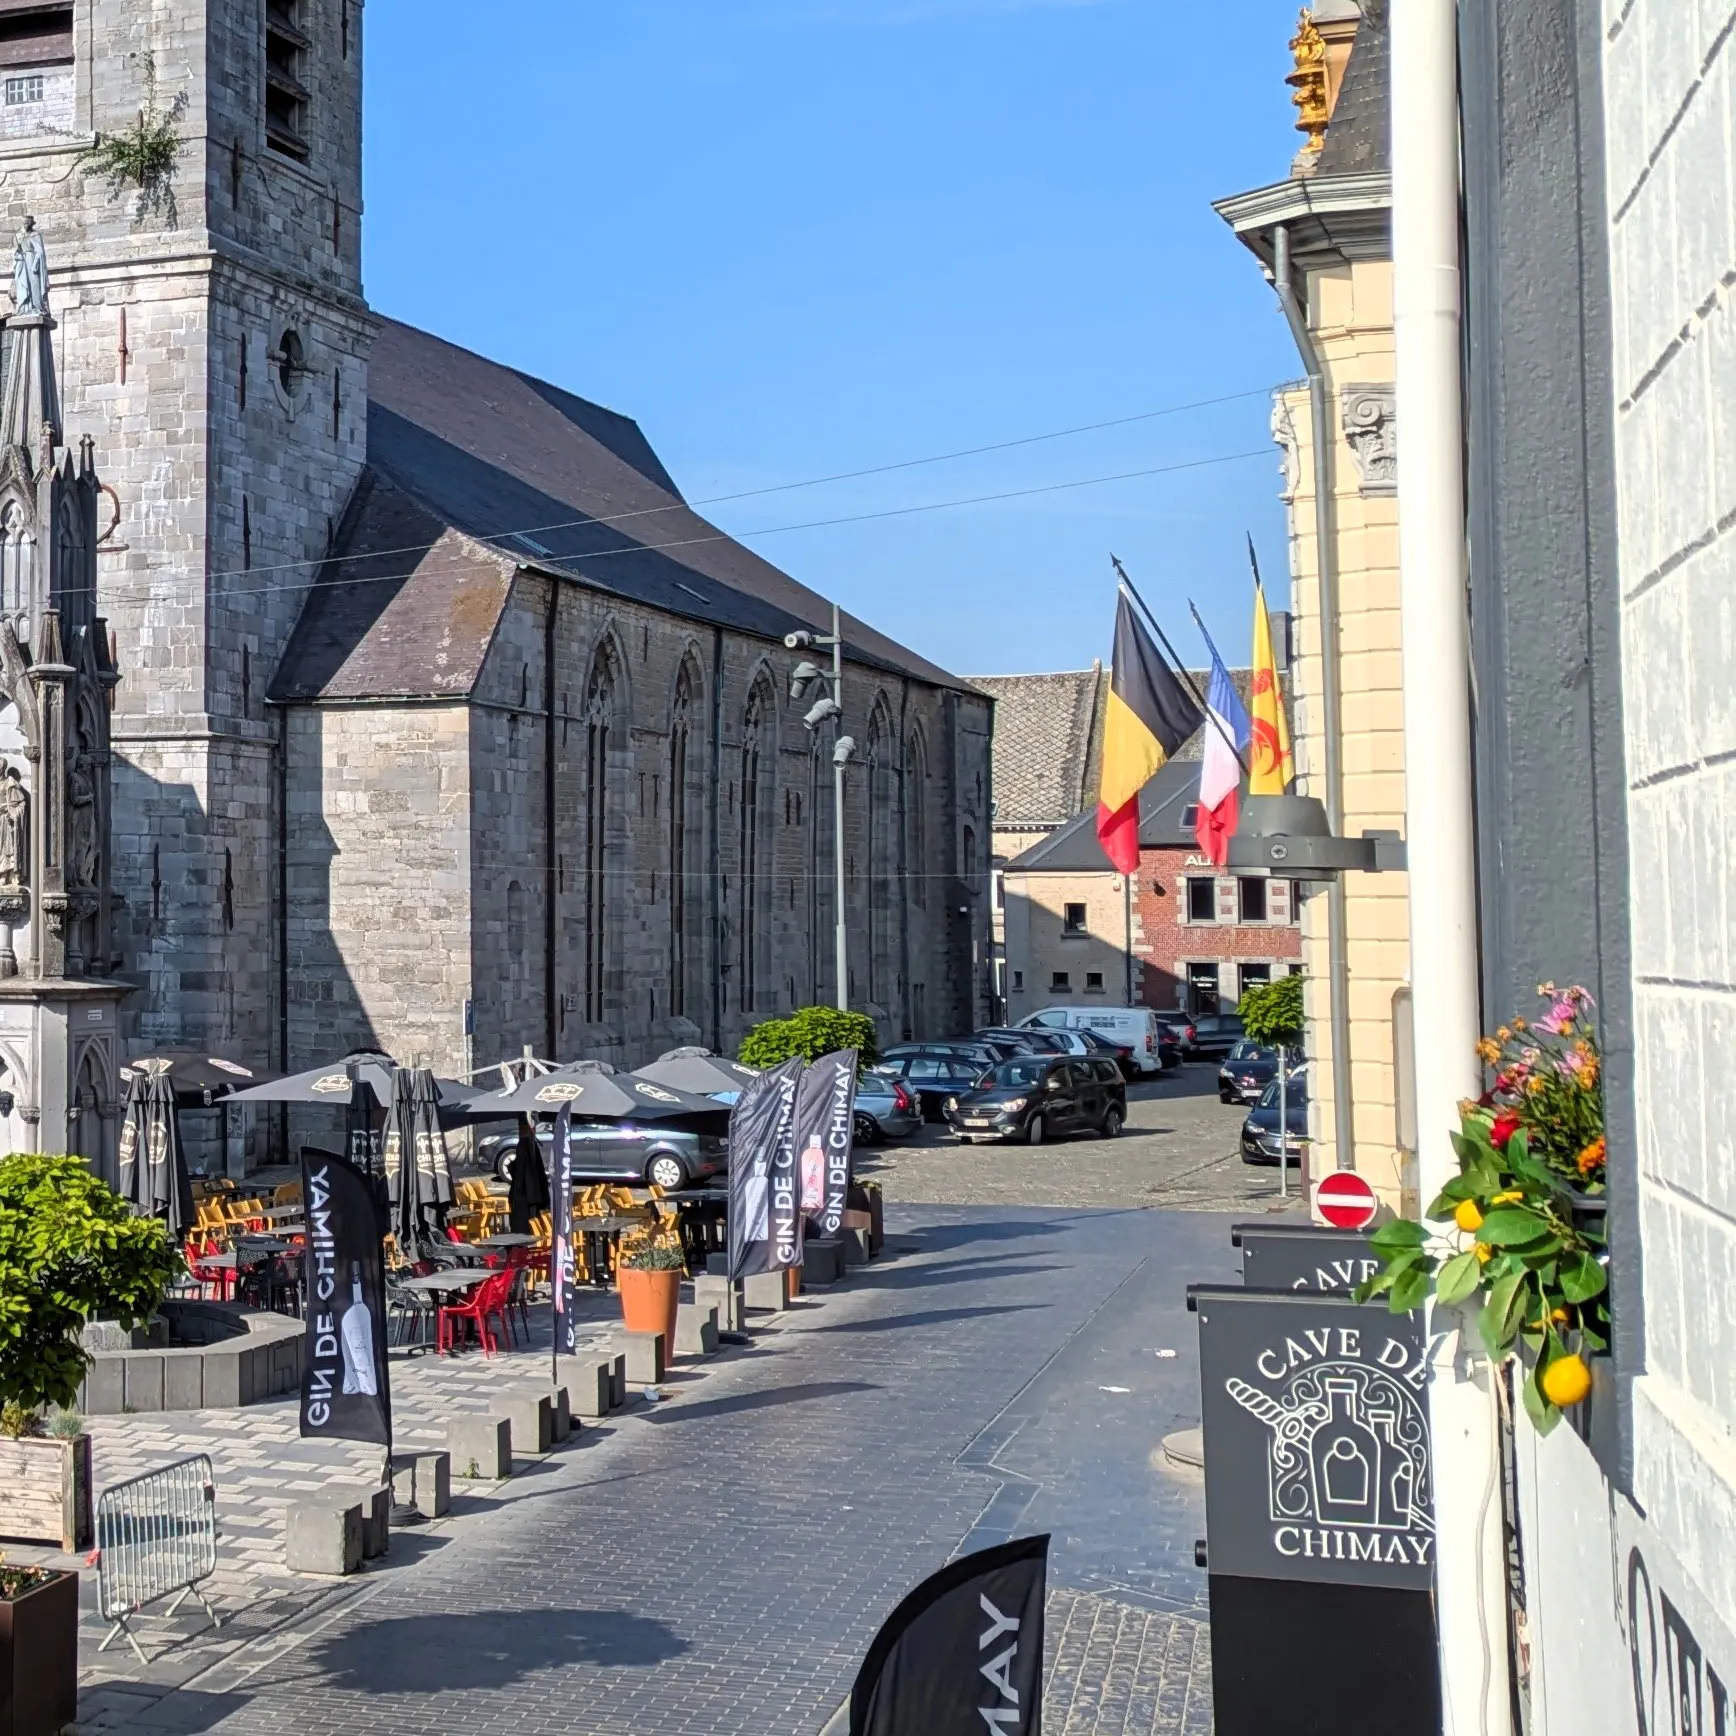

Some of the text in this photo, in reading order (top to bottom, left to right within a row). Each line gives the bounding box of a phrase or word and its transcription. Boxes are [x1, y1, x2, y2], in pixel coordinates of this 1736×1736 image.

[826, 1062, 851, 1233] GIN DE CHIMAY
[775, 1176, 793, 1210] DE
[776, 1218, 795, 1263] GIN
[1257, 1327, 1361, 1380] CAVE
[1275, 1526, 1433, 1565] CHIMAY
